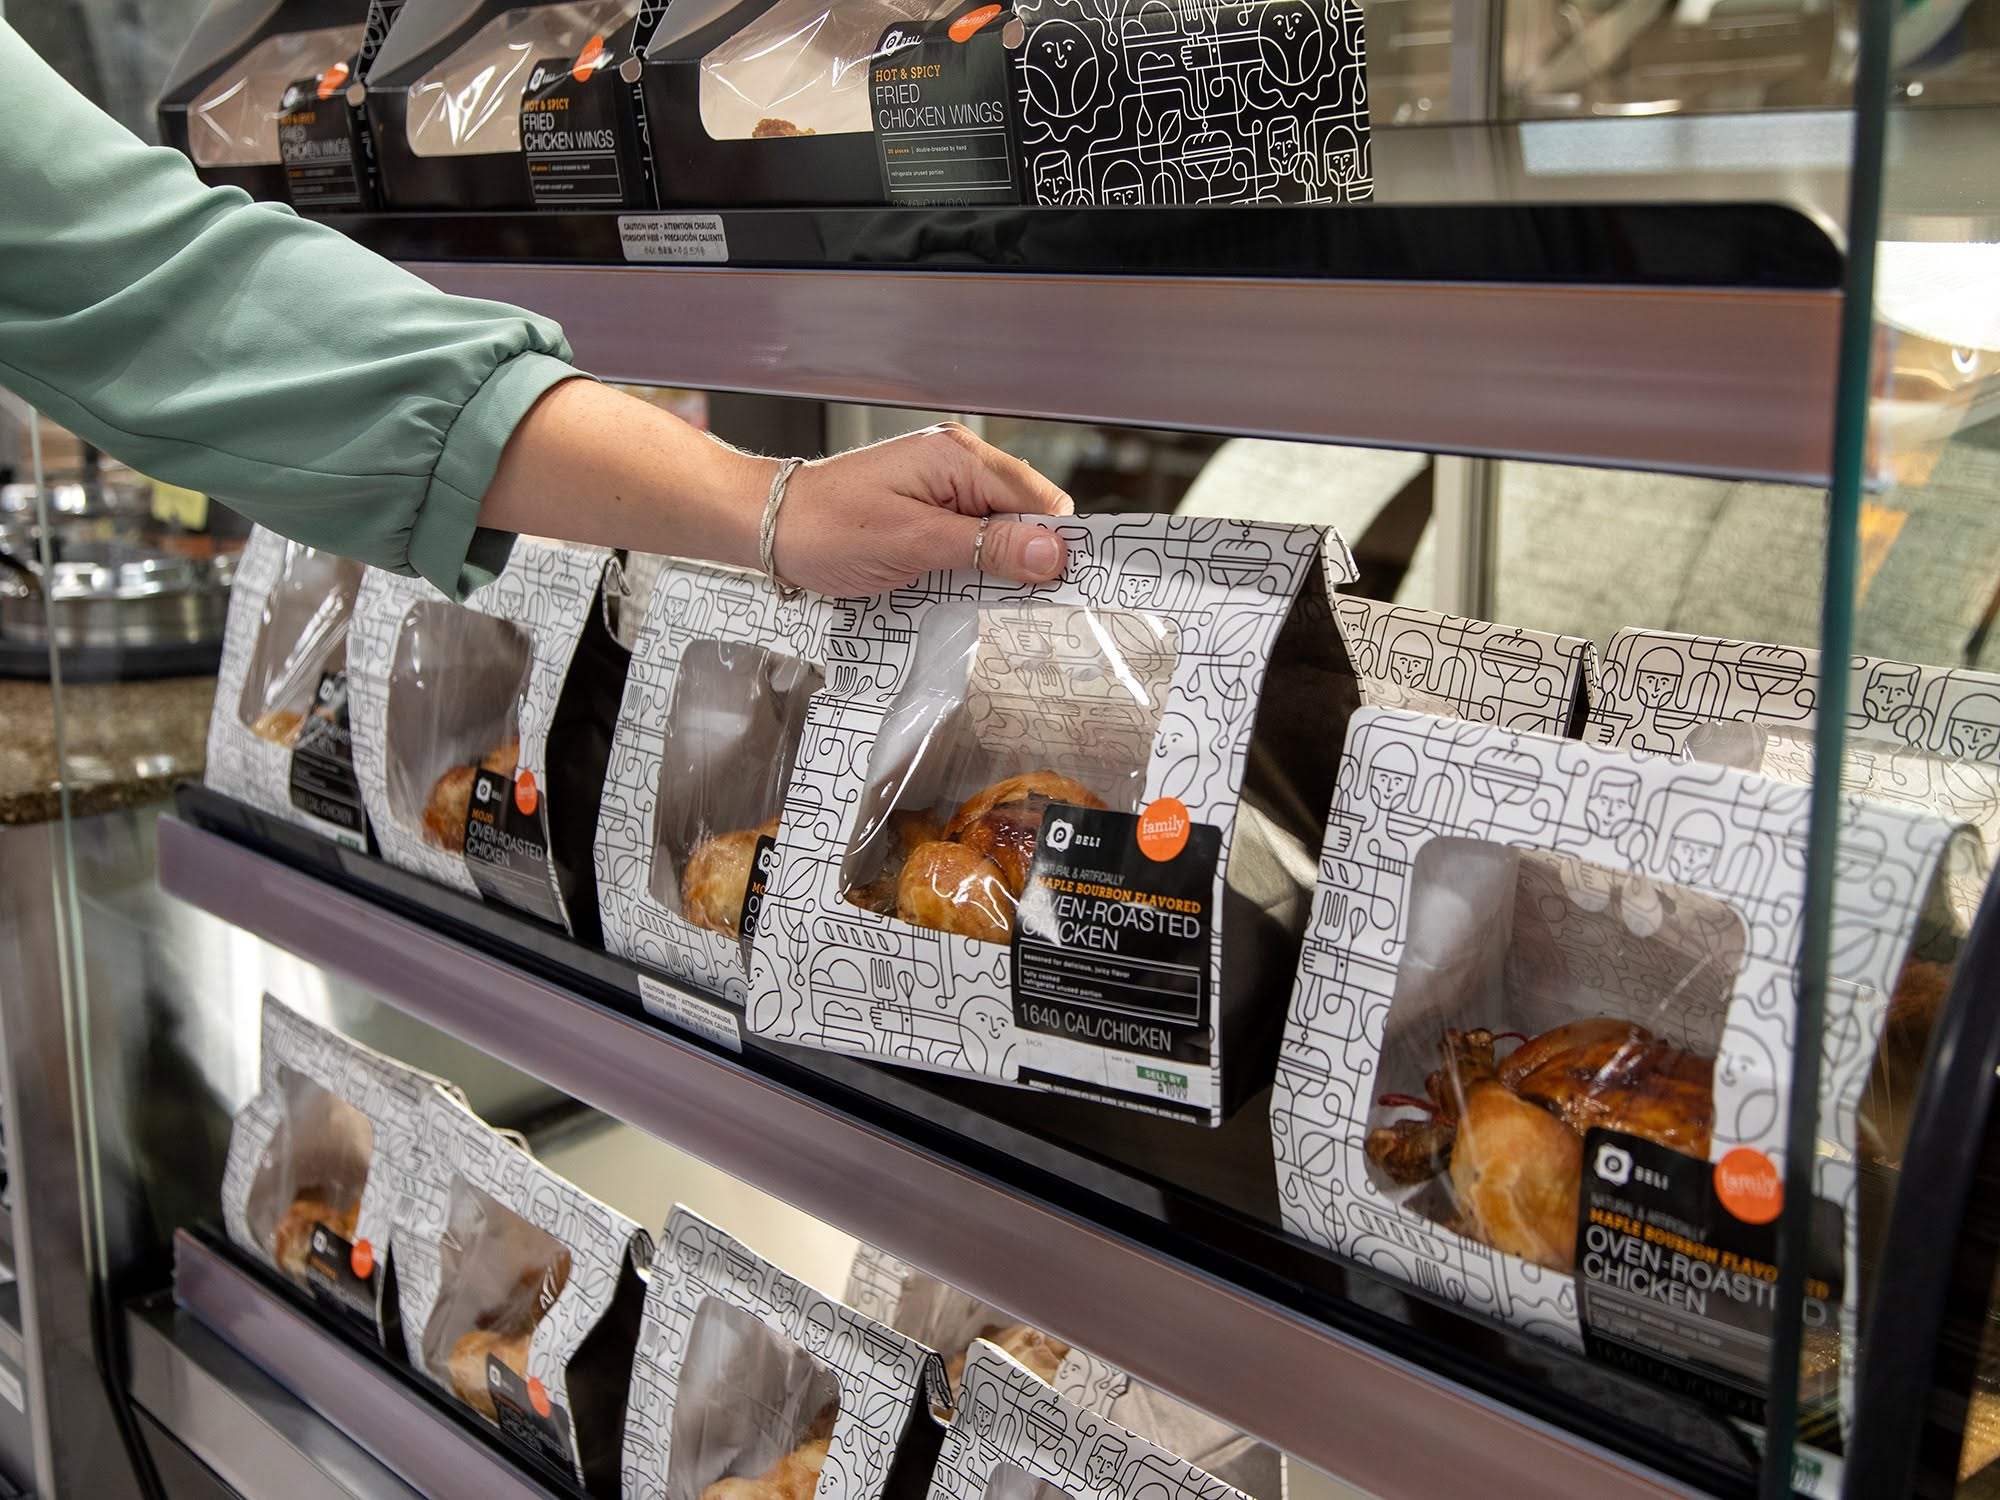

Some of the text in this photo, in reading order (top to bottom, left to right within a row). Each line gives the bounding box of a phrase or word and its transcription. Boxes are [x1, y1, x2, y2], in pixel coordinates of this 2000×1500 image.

[875, 64, 941, 82] HOT & SPICY
[524, 99, 539, 112] HOT
[547, 97, 569, 111] SPICY
[875, 83, 921, 106] FRIED
[523, 112, 555, 132] FRIED
[878, 100, 1005, 130] CHICKEN WINGS
[524, 129, 615, 151] CHICKEN WINGS
[623, 221, 717, 231] CAUTION HOT ATTENTION CHAUDE
[698, 232, 725, 242] CALIENTE
[471, 807, 494, 825] MOJO
[1142, 813, 1185, 839] family
[466, 837, 511, 867] CHICKEN
[468, 819, 544, 862] OVEN-ROASTED
[1074, 833, 1101, 848] DELI
[1071, 867, 1079, 879] &
[1078, 868, 1126, 887] ARTIFICIALLY
[1034, 875, 1202, 915] MAPLE BOURBON FLAVORED
[1031, 890, 1201, 939] OVEN-ROASTED
[1023, 953, 1053, 965] seasoned
[1052, 958, 1063, 967] for
[1094, 965, 1110, 977] juicy
[1110, 968, 1131, 979] flavor
[1023, 969, 1061, 984] fully cooked
[1023, 978, 1104, 999] refrigerate unused portion
[641, 990, 665, 1005] VORSICHT
[713, 1021, 739, 1038] CALIENTE
[642, 981, 666, 997] CAUTION
[665, 991, 677, 1001] HOT
[681, 999, 710, 1016] ATTENTION
[709, 1010, 732, 1026] CHAUDE
[1020, 1002, 1172, 1052] 1640 CAL/CHICKEN
[1144, 1068, 1182, 1086] SELL BY
[1589, 1206, 1642, 1237] MAPLE
[1643, 1221, 1719, 1264] BOURBON
[1582, 1251, 1707, 1316] CHICKEN
